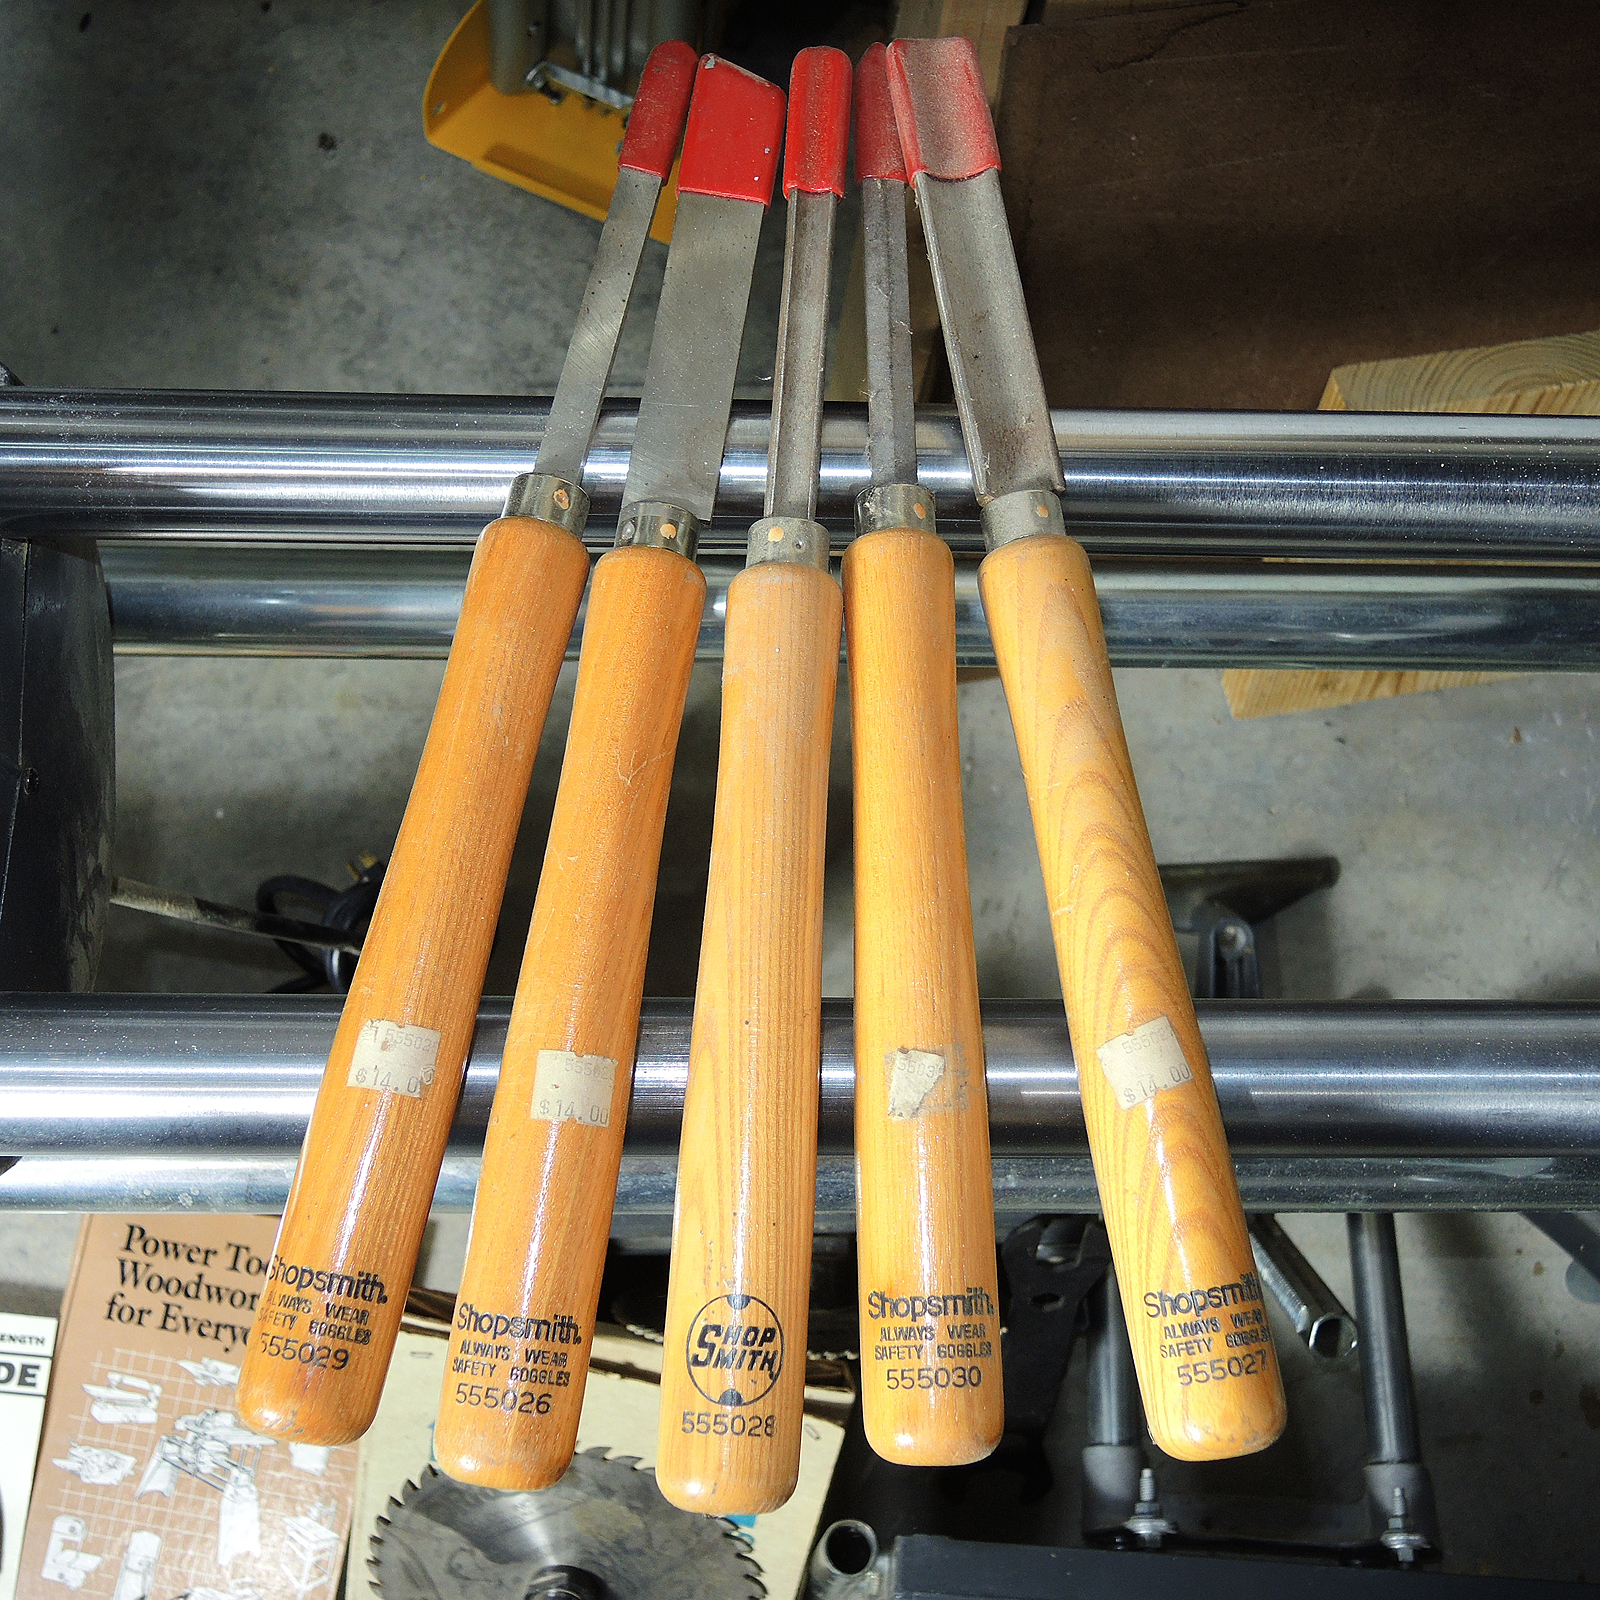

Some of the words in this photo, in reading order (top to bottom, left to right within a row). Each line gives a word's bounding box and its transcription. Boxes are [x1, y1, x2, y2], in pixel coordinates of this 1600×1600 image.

[355, 1065, 435, 1094] $14.00
[1123, 1063, 1190, 1104] $14.00
[539, 1099, 609, 1125] $14.00
[120, 1222, 218, 1267] Power
[103, 1292, 152, 1328] for
[266, 1291, 312, 1315] ALWAYS
[325, 1301, 370, 1326] WEAR
[257, 1307, 299, 1331] SAFETY
[309, 1319, 372, 1346] GOGGLES
[697, 1324, 777, 1349] SHOP
[880, 1325, 935, 1342] ALWAYS
[947, 1323, 986, 1340] WEAR
[1163, 1316, 1221, 1339] ALWAYS
[260, 1332, 350, 1371] 555029
[460, 1339, 511, 1361] ALWAYS
[525, 1347, 568, 1368] WEAR
[874, 1345, 924, 1361] SAFETY
[936, 1341, 992, 1359] GOGGLES
[1160, 1337, 1213, 1359] SAFETY
[452, 1357, 497, 1378] SAFETY
[509, 1366, 571, 1388] GOGGLES
[886, 1365, 982, 1390] 555030
[1177, 1348, 1267, 1386] 555027
[455, 1382, 553, 1415] 555026
[681, 1410, 778, 1438] 555028
